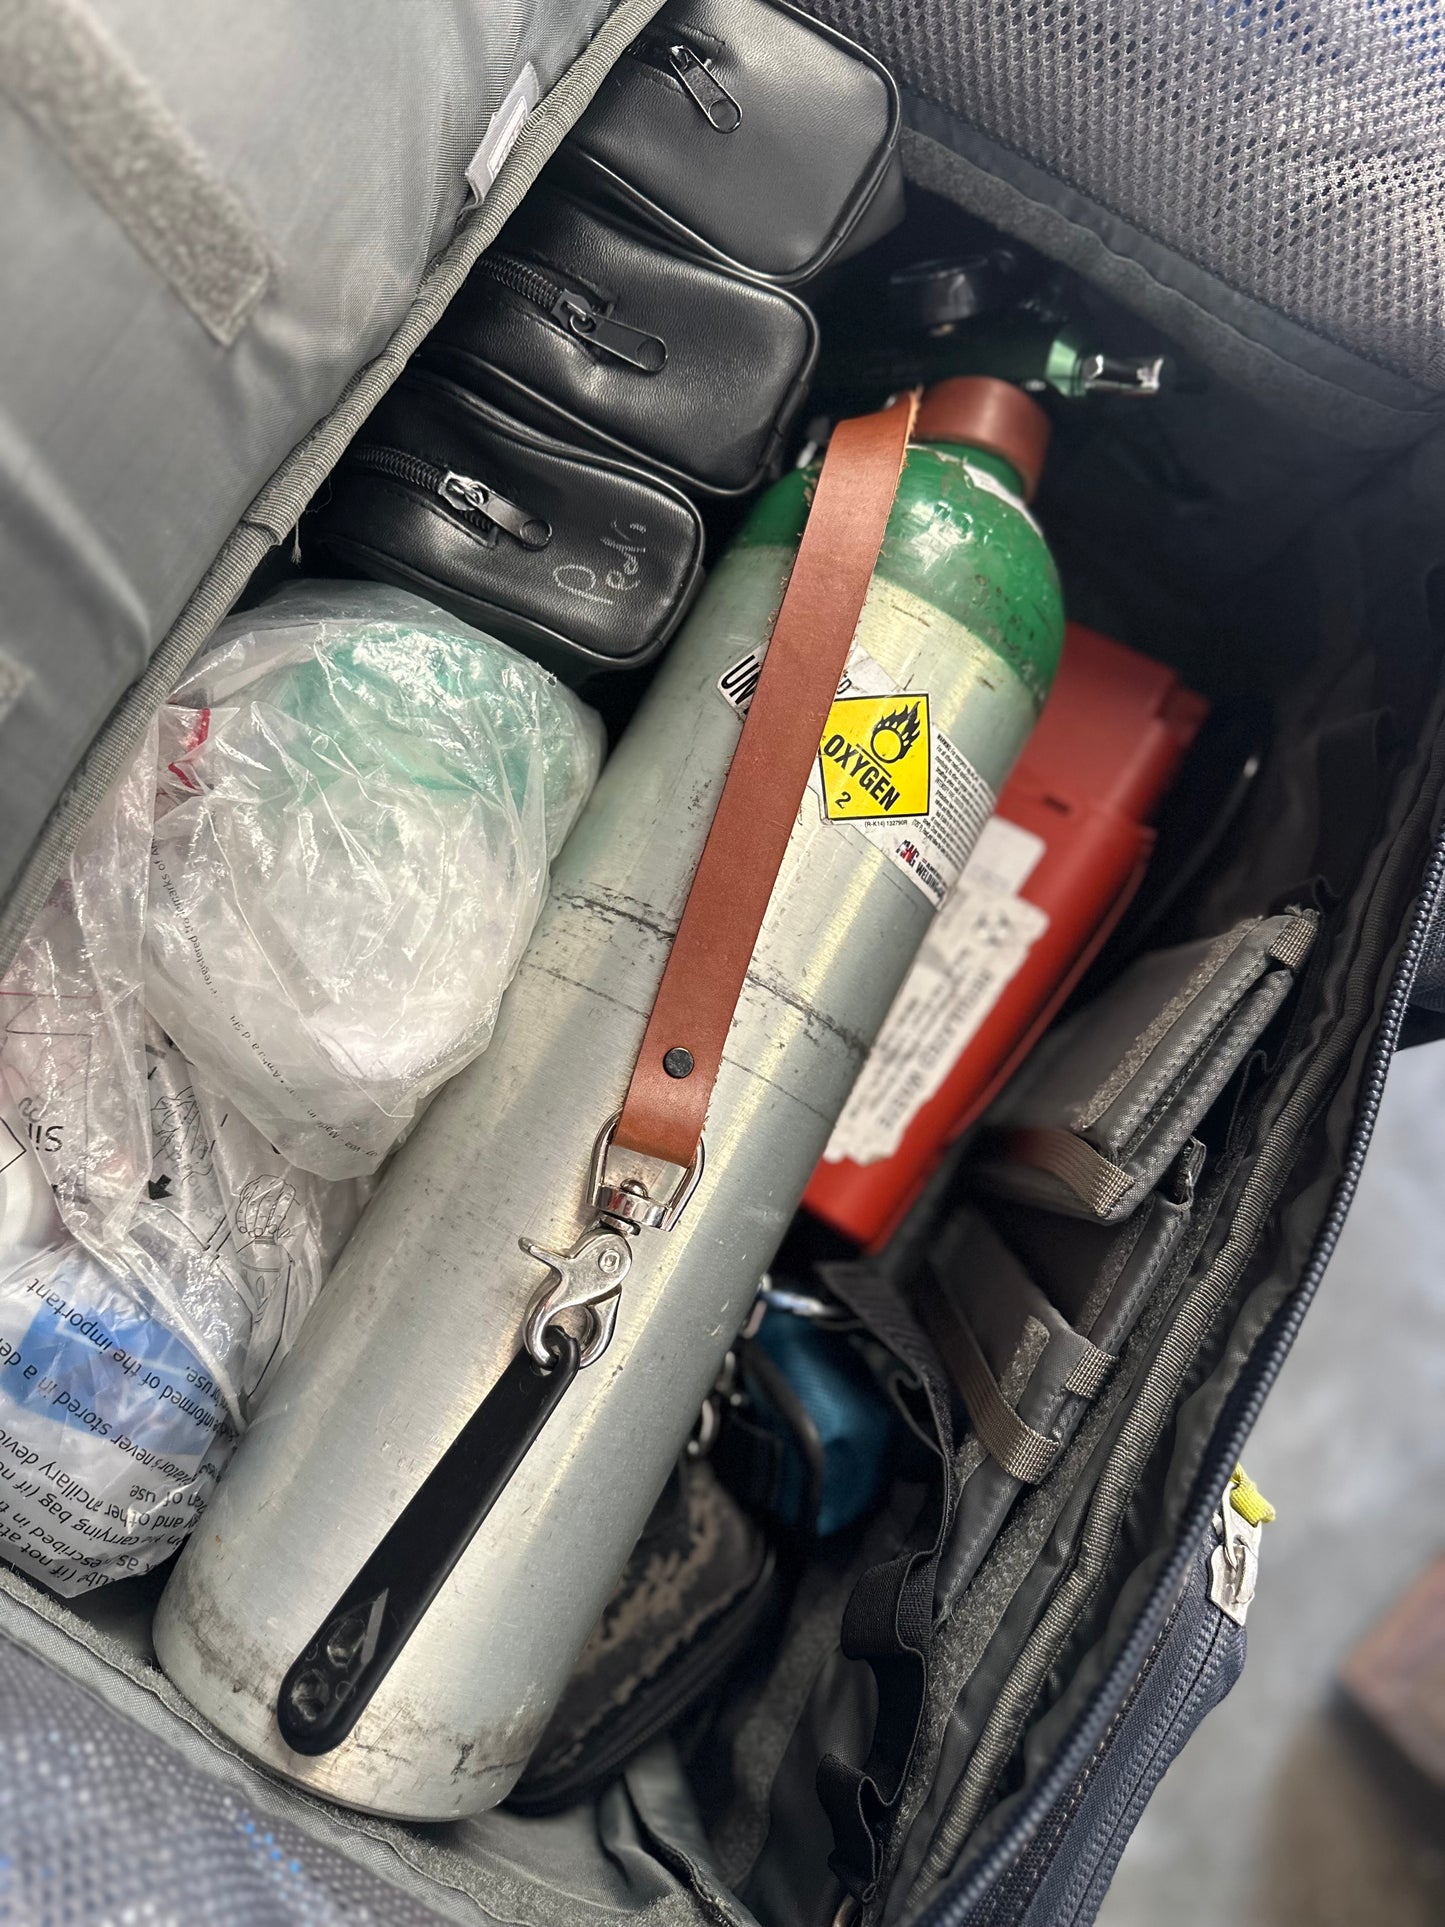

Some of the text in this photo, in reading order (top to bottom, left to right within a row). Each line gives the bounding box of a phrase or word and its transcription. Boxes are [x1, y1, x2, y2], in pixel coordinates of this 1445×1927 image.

[823, 734, 901, 812] OXYGEN
[835, 791, 852, 809] 2
[26, 1278, 113, 1354] important
[0, 1338, 22, 1368] de
[112, 1348, 142, 1378] the
[23, 1364, 38, 1380] a
[138, 1372, 160, 1390] of
[185, 1366, 212, 1394] use.
[38, 1378, 57, 1398] in
[52, 1390, 112, 1436] stored
[158, 1384, 215, 1432] informed
[110, 1434, 156, 1465] never
[12, 1480, 40, 1498] (if
[38, 1461, 104, 1513] ancillary
[12, 1512, 32, 1528] in
[38, 1492, 72, 1524] bag
[104, 1500, 150, 1528] other
[152, 1514, 184, 1530] and
[70, 1518, 140, 1547] carrying
[20, 1542, 53, 1566] not
[28, 1527, 113, 1569] escribed
[50, 1565, 77, 1582] (if
[116, 1554, 139, 1572] as
